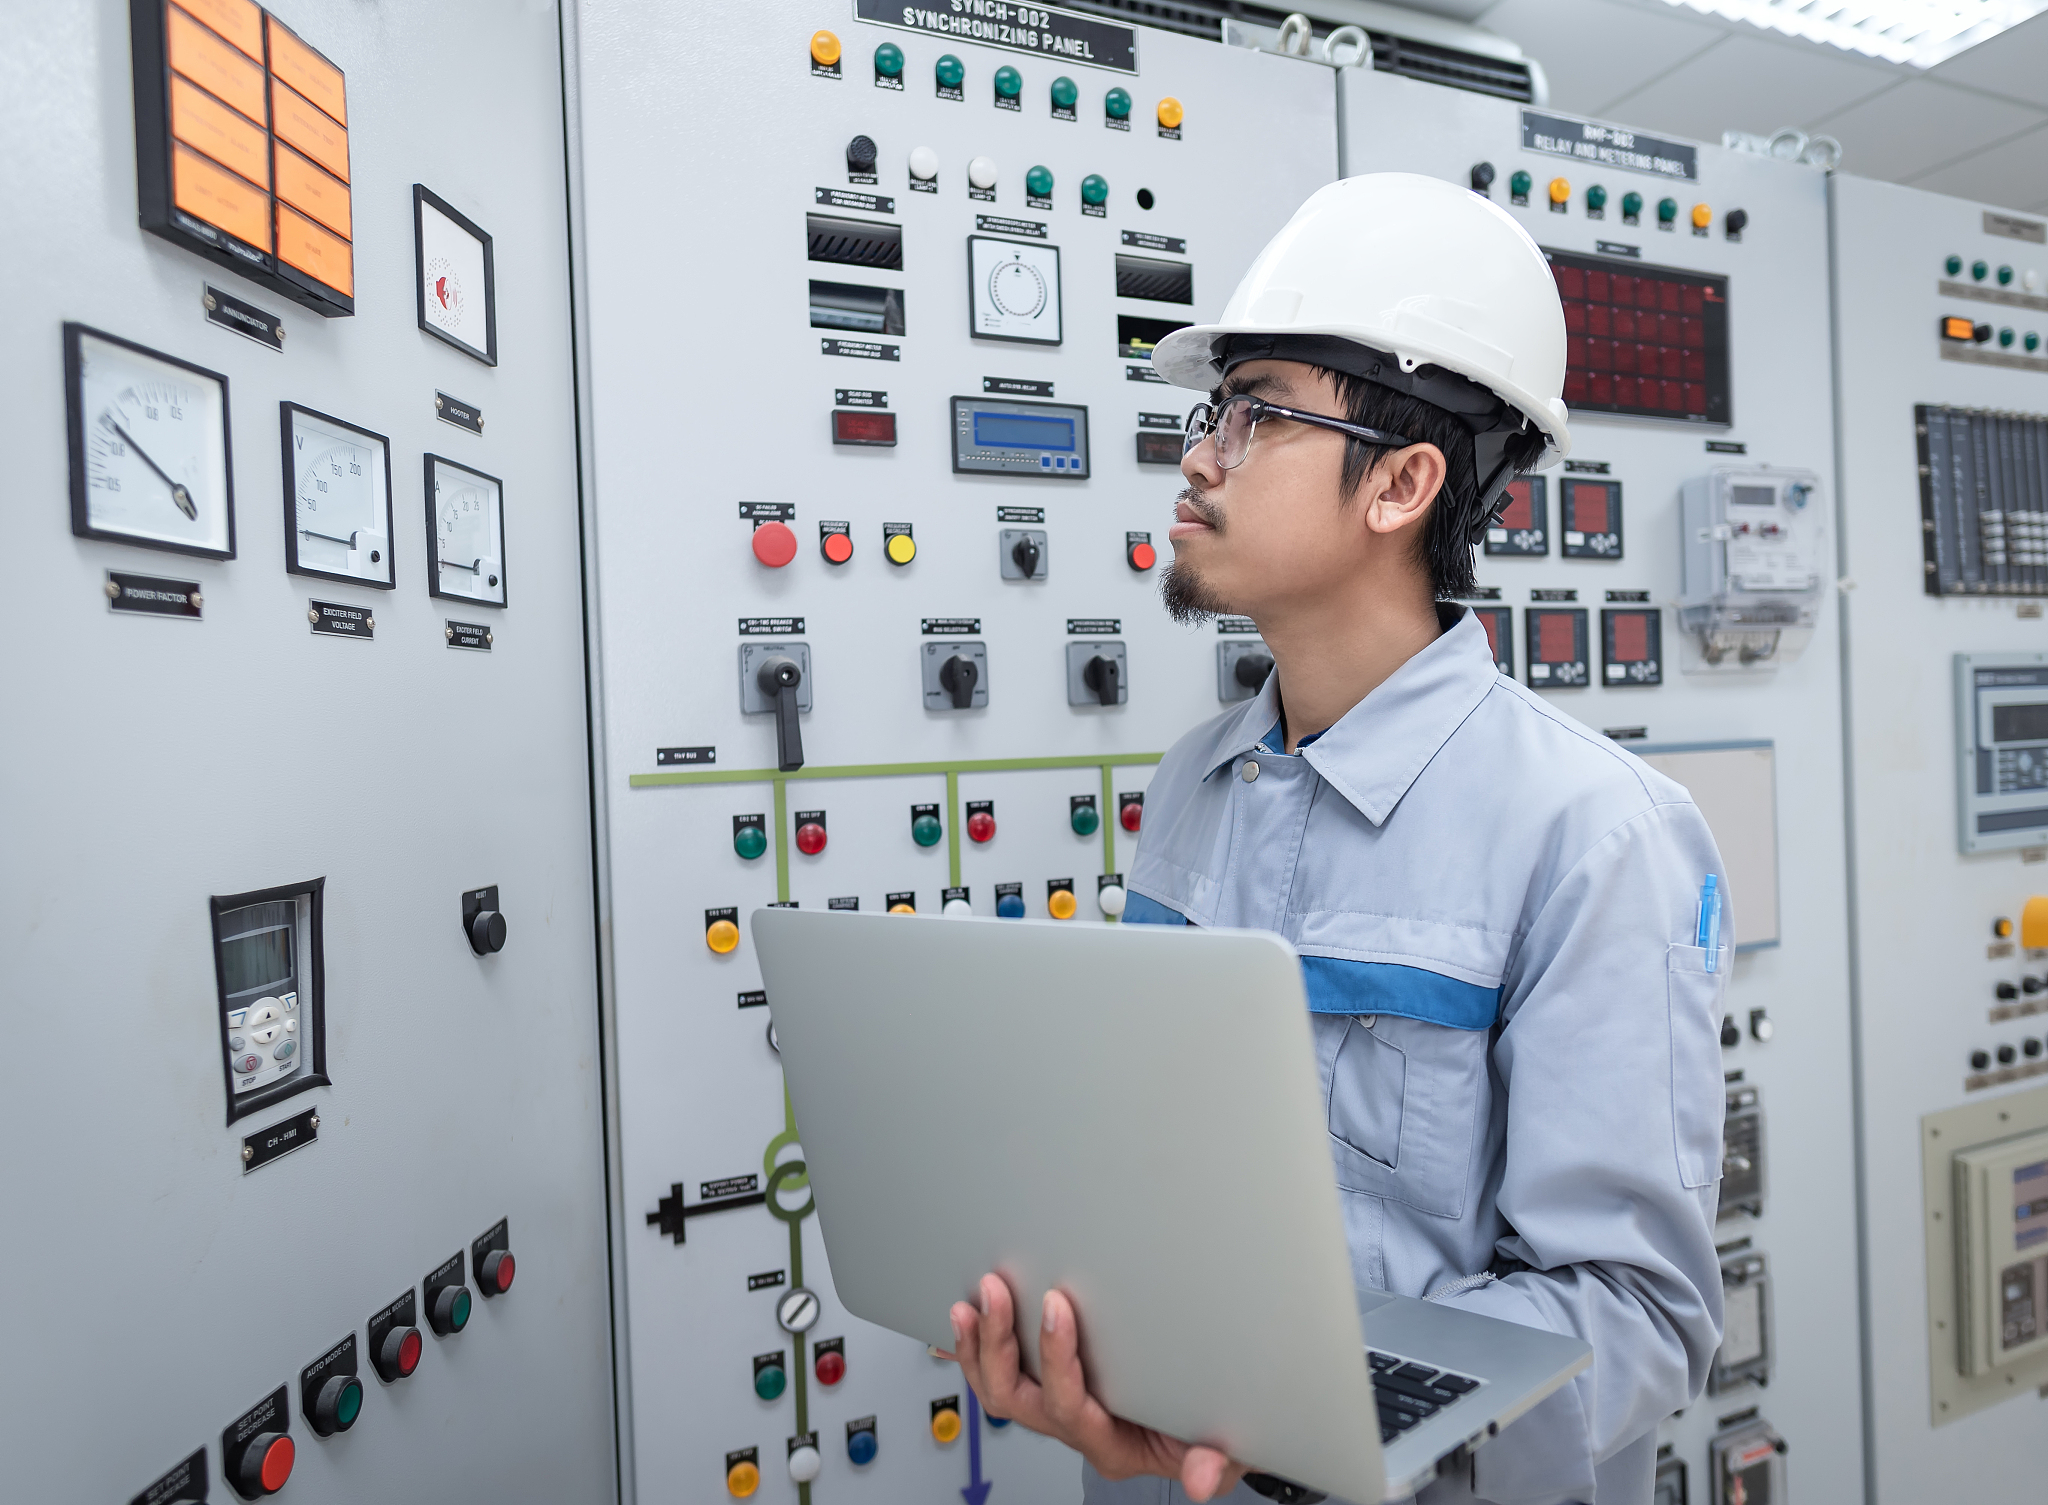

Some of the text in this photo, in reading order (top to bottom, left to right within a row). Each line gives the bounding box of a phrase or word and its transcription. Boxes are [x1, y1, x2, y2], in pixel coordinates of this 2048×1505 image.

[950, 0, 1050, 30] SYNCH-002
[902, 7, 1094, 59] SYNCHRONIZING PANEL
[1534, 133, 1687, 178] RELAY AND METERING PANEL
[223, 306, 268, 332] ANNUNCIATOR
[171, 404, 183, 421] 0.5
[450, 406, 470, 421] HOOTER
[295, 435, 304, 451] V
[331, 462, 342, 478] 150
[349, 462, 362, 477] 200
[316, 479, 328, 494] 100
[435, 480, 441, 494] A
[307, 498, 317, 512] 50
[462, 501, 469, 512] 20
[473, 500, 480, 511] 25
[453, 509, 458, 521] 15
[446, 521, 453, 533] 10
[442, 538, 446, 549] 5
[127, 587, 188, 604] POWER FACTOR
[348, 611, 362, 620] FIELD
[331, 620, 356, 631] VOLTAGE
[456, 625, 483, 636] EXCITER FIELD
[461, 636, 480, 645] CURRENT
[279, 1061, 292, 1072] START
[242, 1076, 256, 1087] STOP
[267, 1136, 279, 1148] CH
[283, 1128, 297, 1141] HMI
[477, 1224, 503, 1248] PF MODE OFF
[431, 1257, 458, 1283] PF MODE ON
[371, 1292, 412, 1328] MANUAL MODE ON
[306, 1339, 352, 1379] AUTO MODE ON
[238, 1397, 274, 1431] SET POINT
[238, 1407, 276, 1442] DECREASE
[146, 1461, 191, 1501] SET POINT
